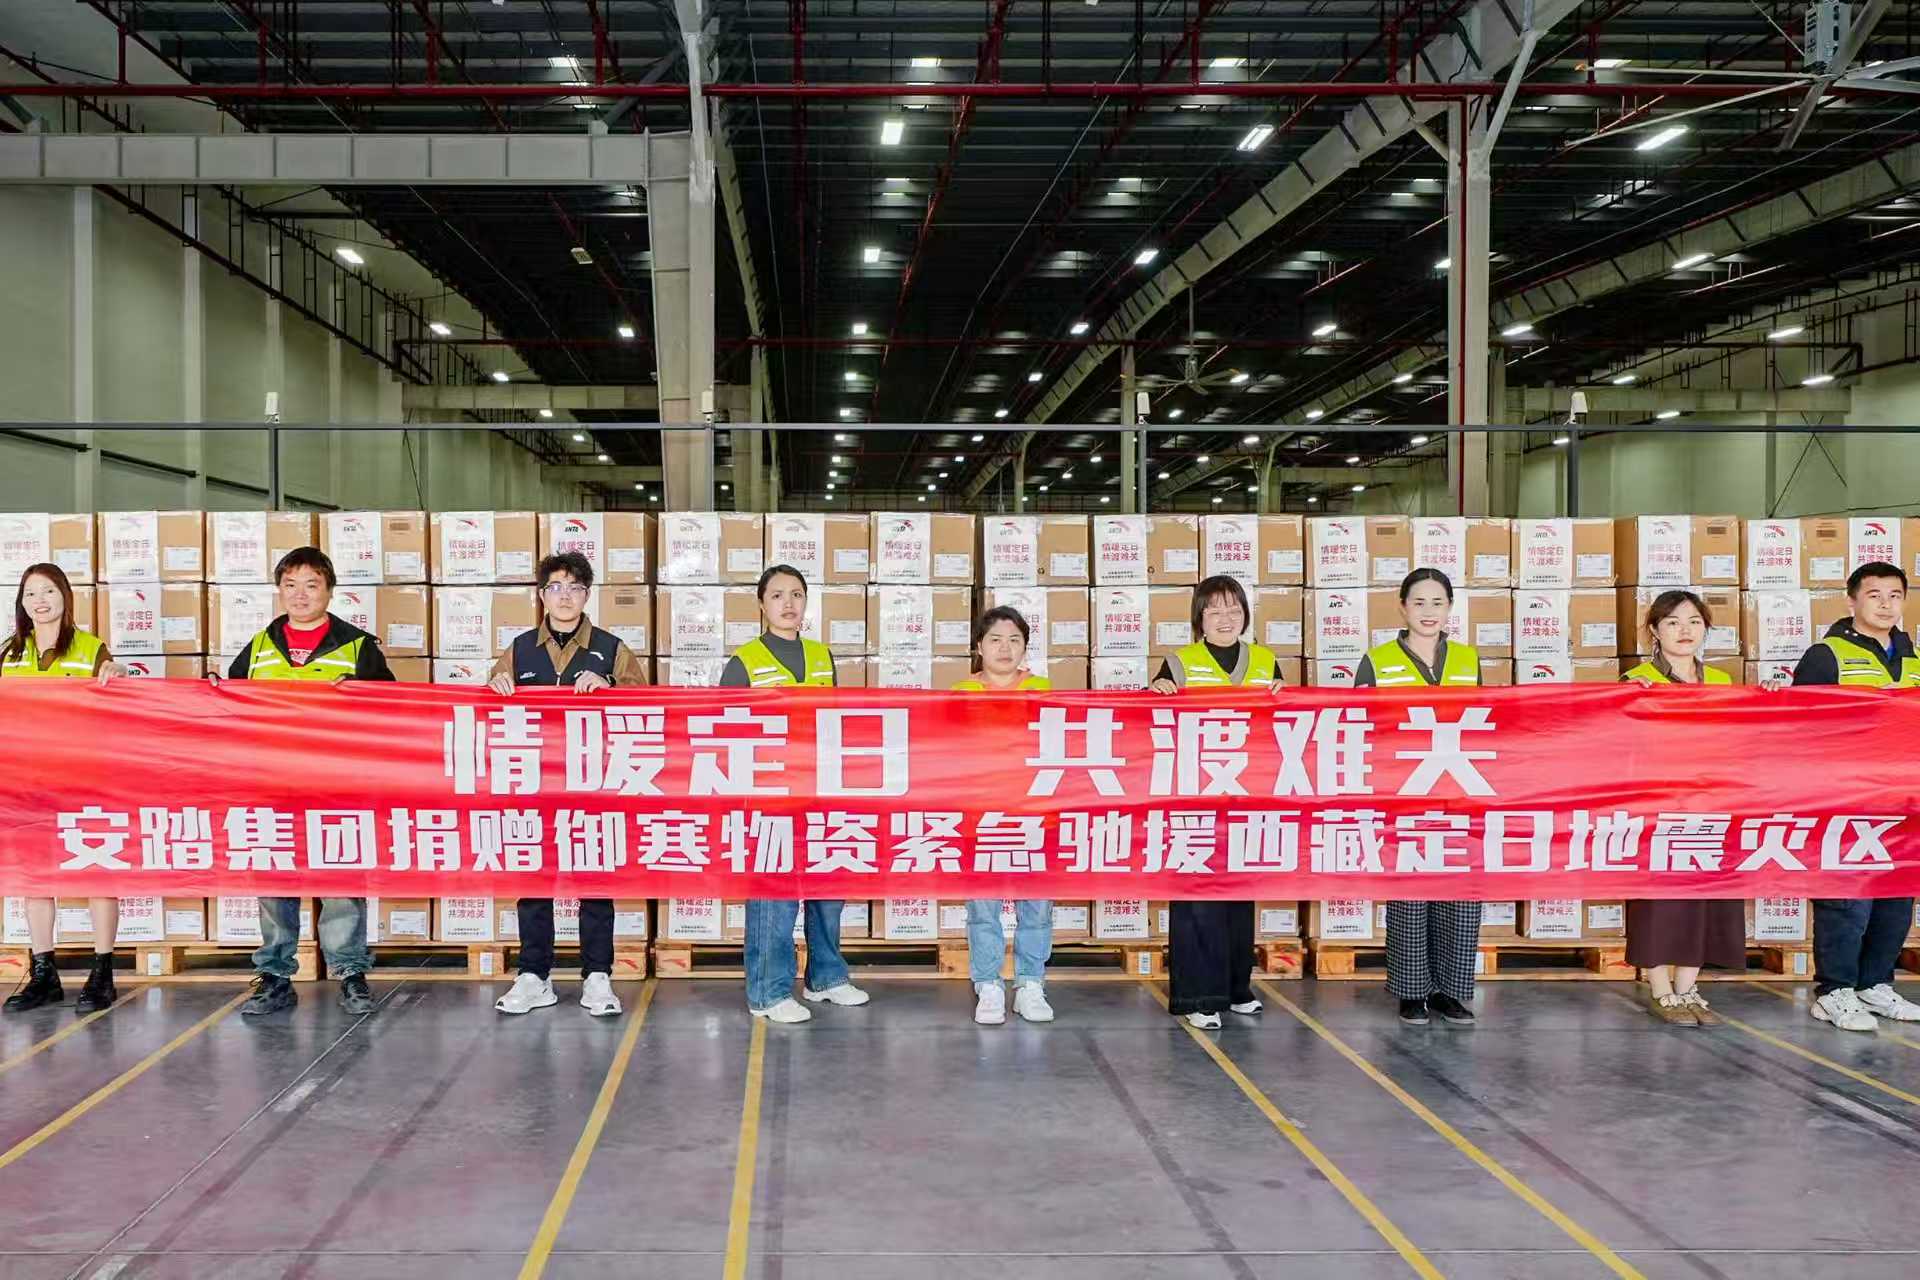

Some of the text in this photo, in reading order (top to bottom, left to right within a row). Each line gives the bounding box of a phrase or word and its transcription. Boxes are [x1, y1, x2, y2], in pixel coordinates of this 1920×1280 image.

[443, 705, 1497, 797] 情暖定日 共渡难关
[57, 806, 1907, 873] 安踏集团捐赠御寒物资紧急驰援西藏定日地震灾区
